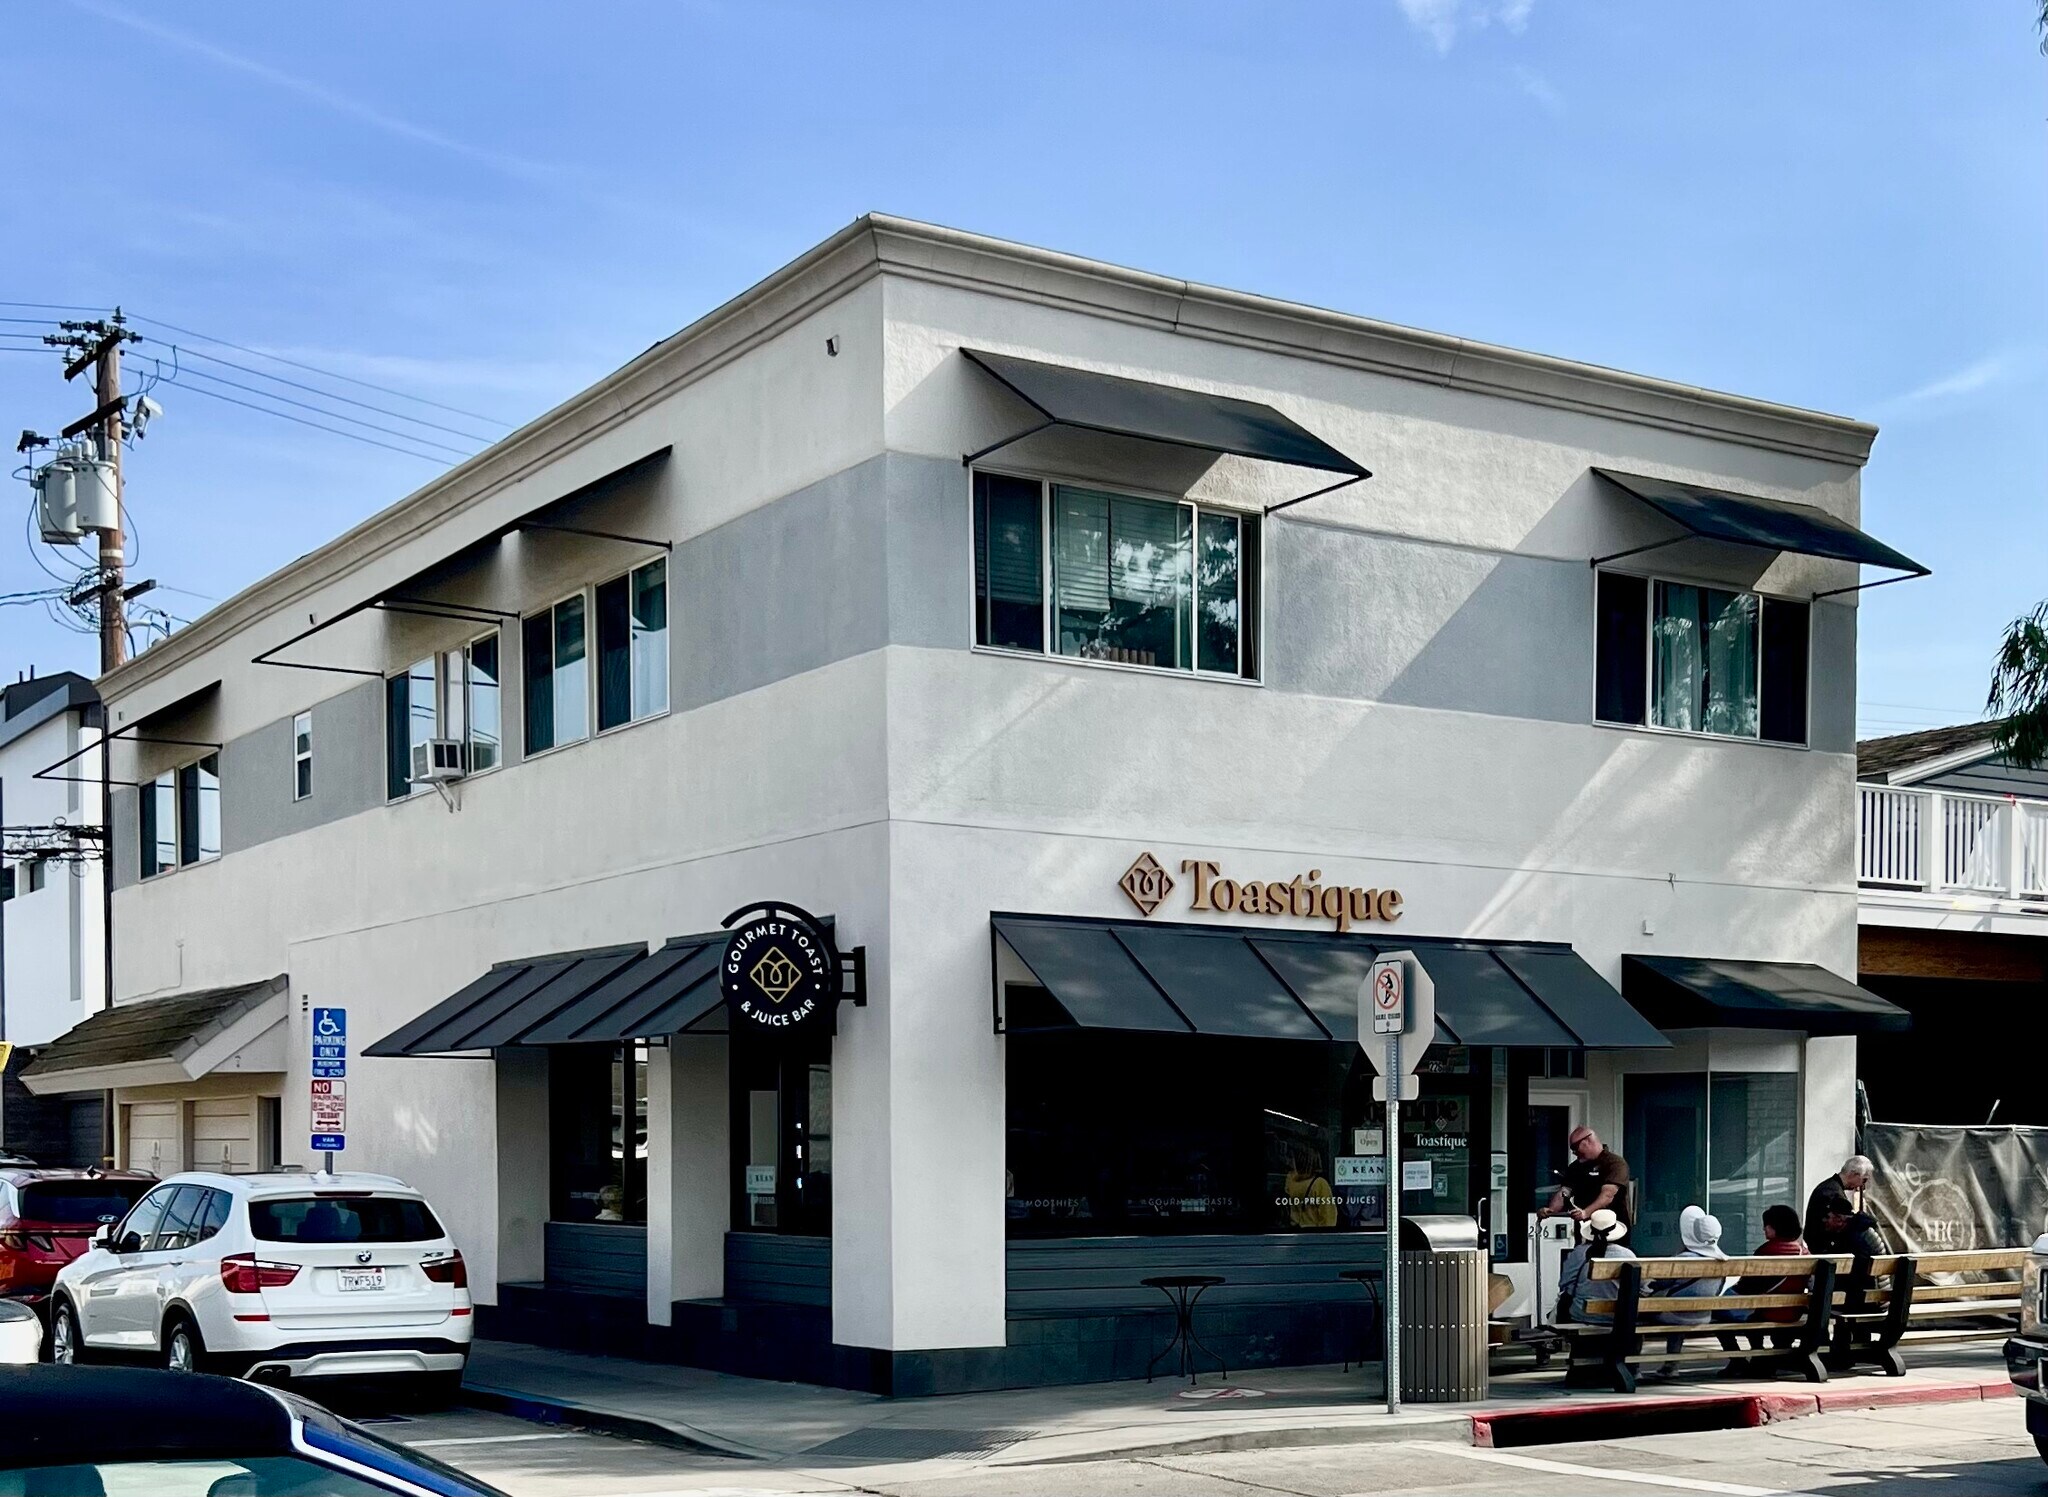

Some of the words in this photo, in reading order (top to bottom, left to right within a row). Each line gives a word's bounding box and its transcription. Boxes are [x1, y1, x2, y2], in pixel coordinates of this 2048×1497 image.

[1181, 859, 1404, 932] Toastique
[728, 923, 786, 974] GOURMET
[791, 929, 823, 975] TOAST
[741, 1000, 751, 1012] &
[751, 1009, 790, 1026] JUICE
[792, 999, 815, 1022] BAR
[314, 1035, 345, 1046] PARKING
[320, 1047, 339, 1057] ONLY
[313, 1082, 329, 1093] NO
[1413, 1133, 1467, 1150] Toastique
[1352, 1166, 1384, 1174] KEAN
[1148, 1198, 1195, 1207] GOURM
[1346, 1196, 1376, 1205] JUICES
[1528, 1225, 1549, 1238] 26
